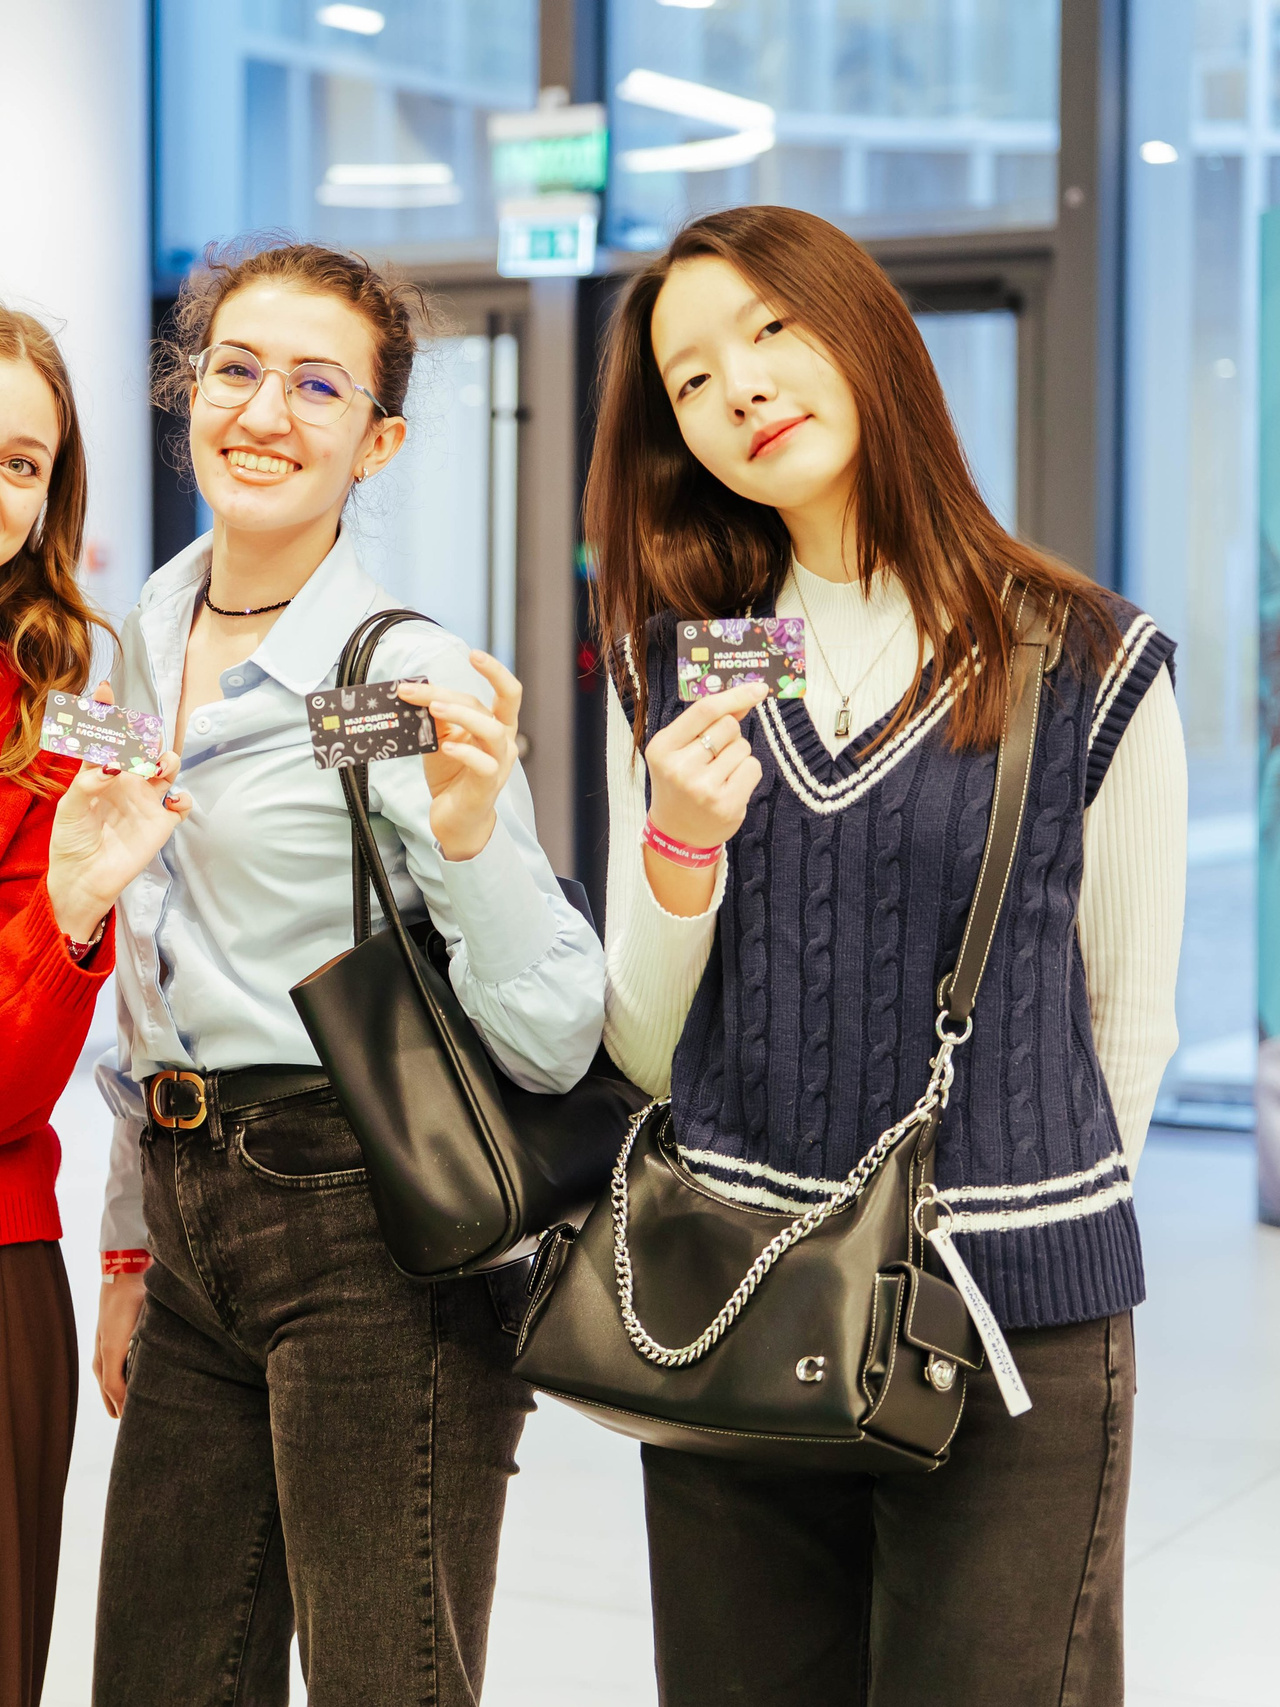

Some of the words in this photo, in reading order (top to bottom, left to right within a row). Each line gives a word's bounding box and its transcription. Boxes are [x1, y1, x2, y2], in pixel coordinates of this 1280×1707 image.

[713, 658, 770, 669] МОСКВЫ
[345, 719, 400, 736] МОСКВЫ
[76, 728, 126, 746] МОСКВЫ
[965, 1286, 989, 1328] ВМЕСТЕ
[1000, 1347, 1020, 1391] УСПЕХУ
